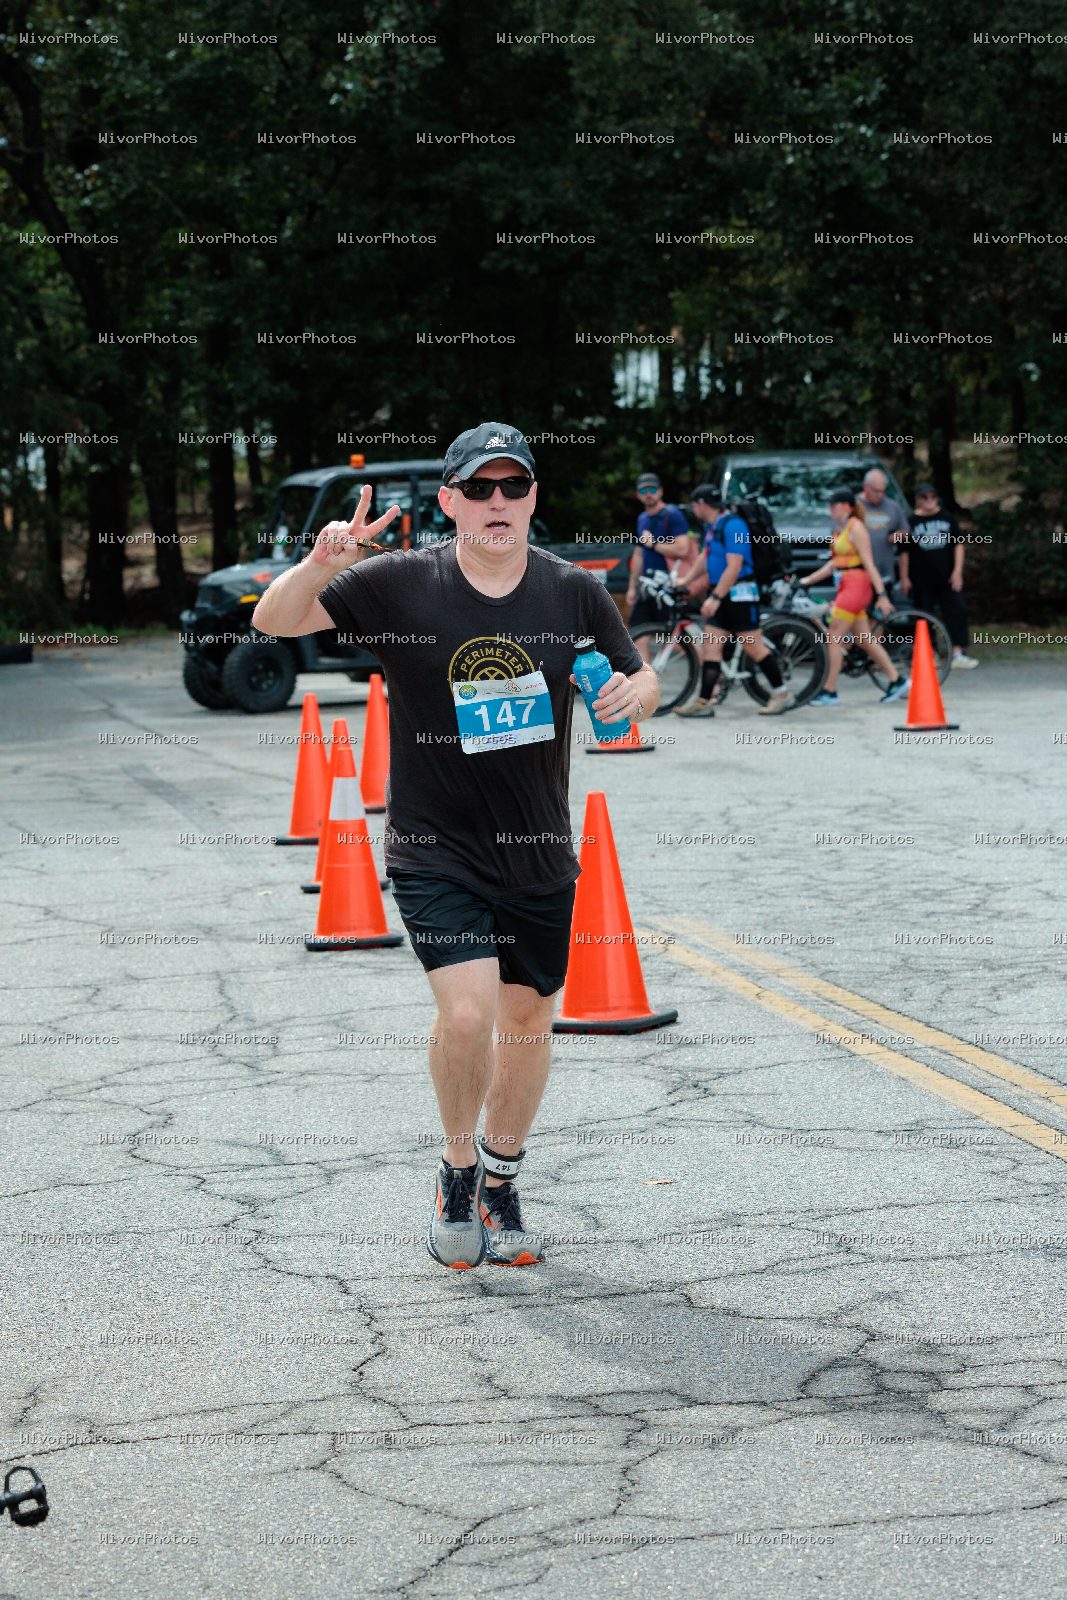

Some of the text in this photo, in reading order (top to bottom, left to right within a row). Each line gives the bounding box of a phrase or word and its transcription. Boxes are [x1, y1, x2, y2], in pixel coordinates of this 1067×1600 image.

[461, 647, 523, 673] PERIMETER
[474, 698, 536, 732] 147
[495, 1163, 510, 1171] 147
